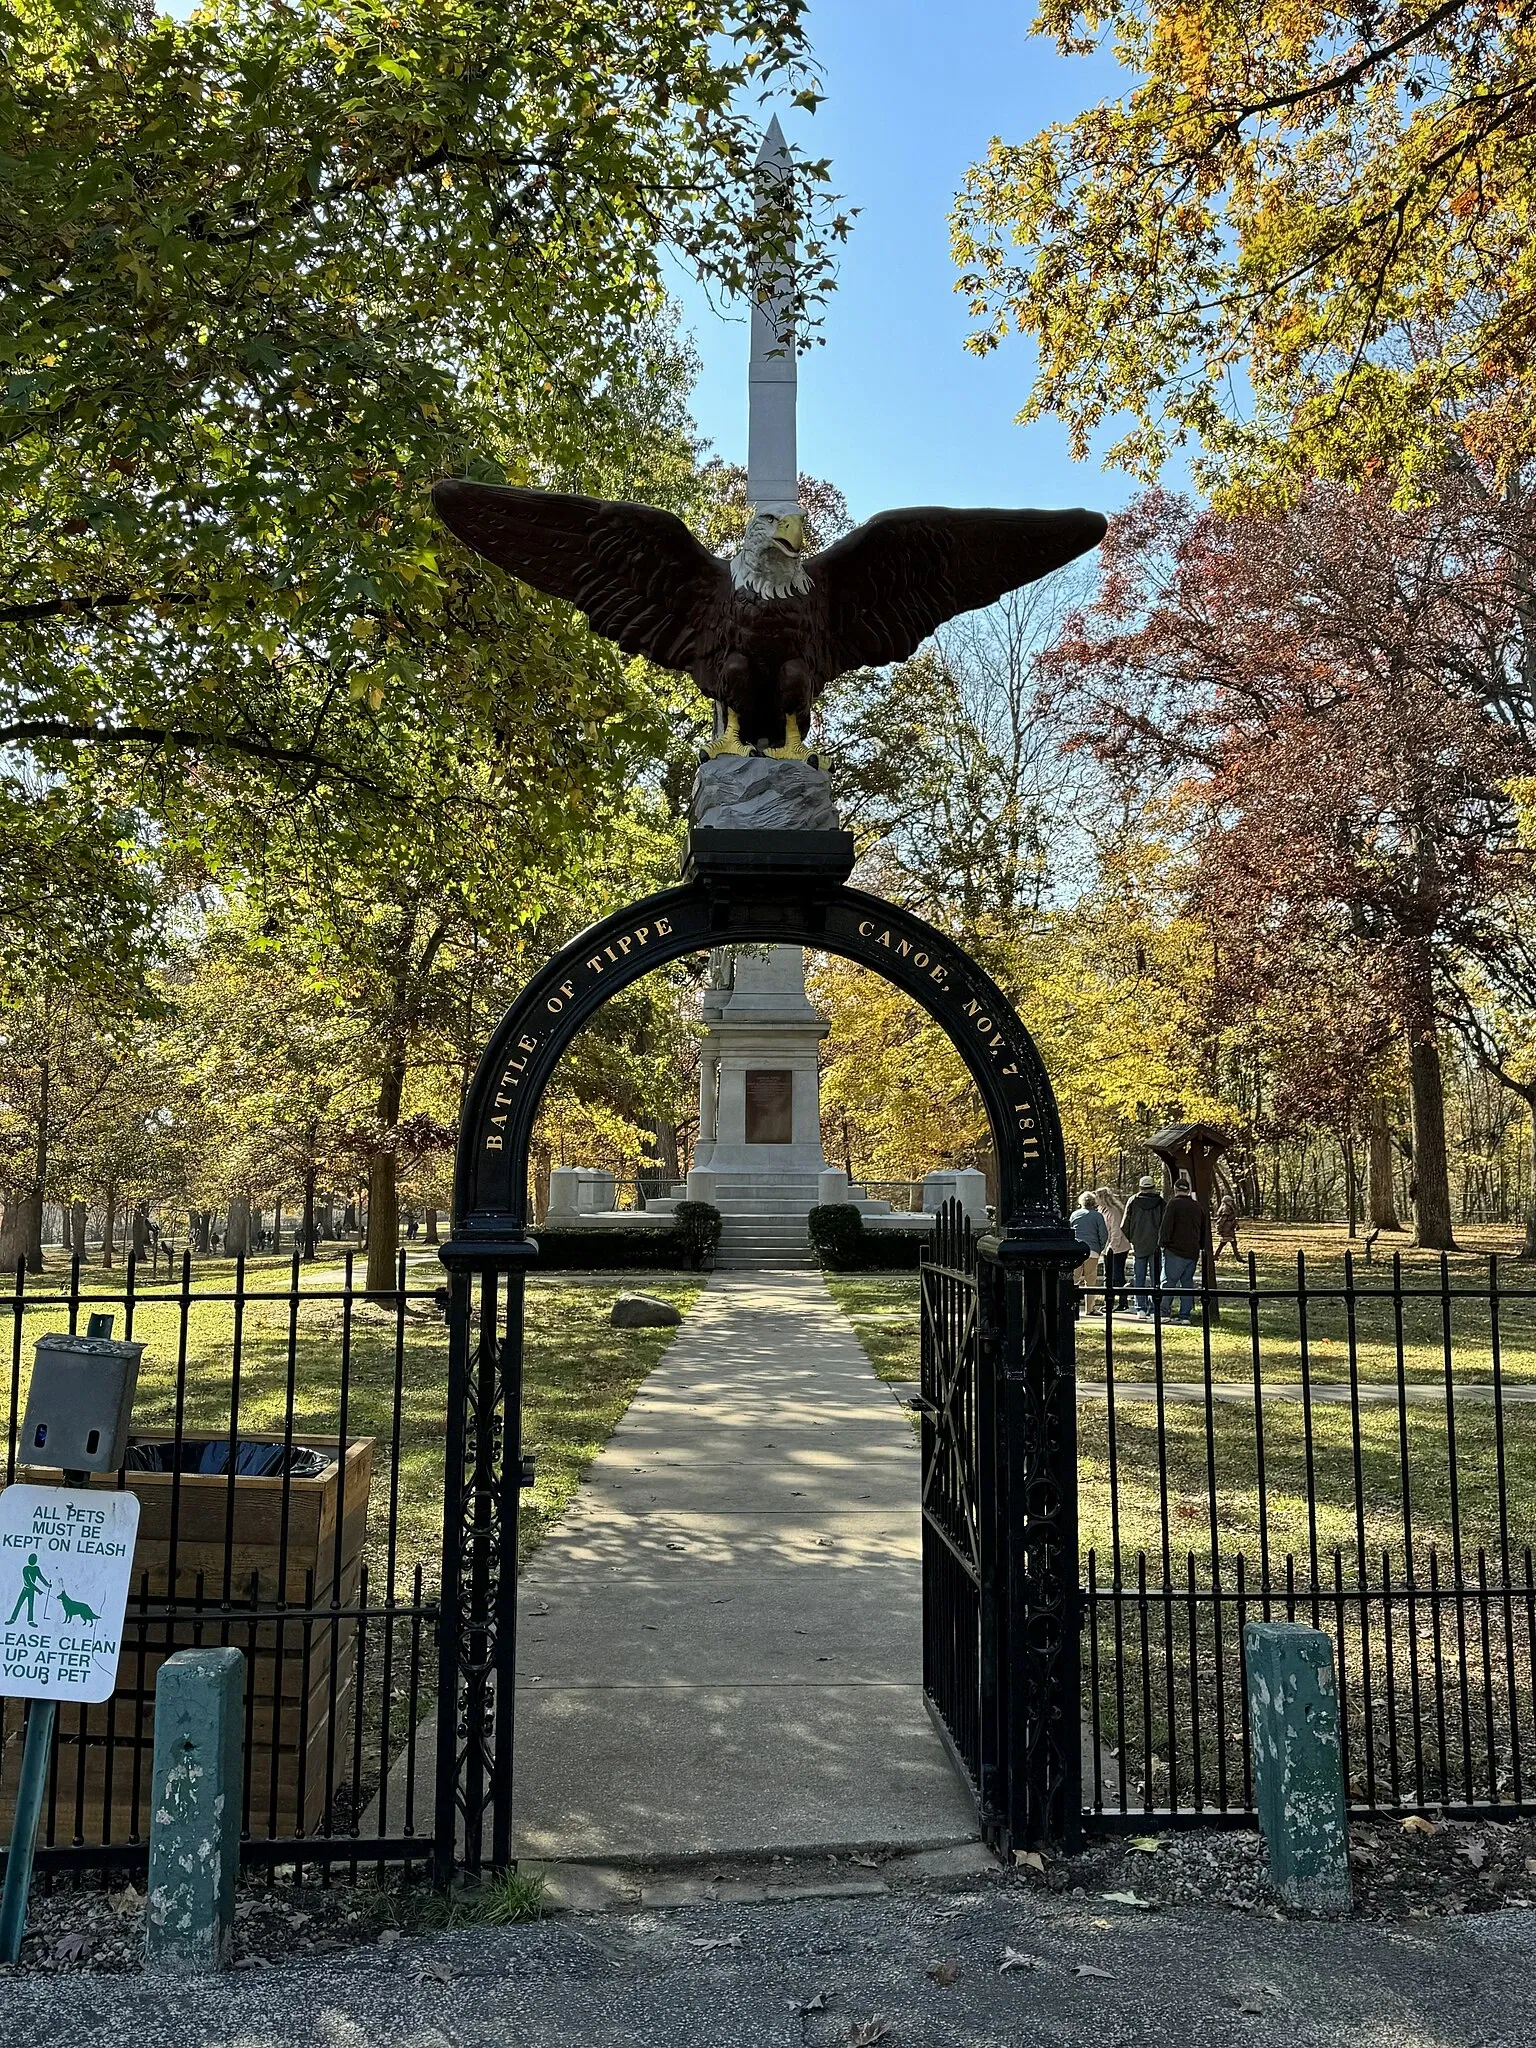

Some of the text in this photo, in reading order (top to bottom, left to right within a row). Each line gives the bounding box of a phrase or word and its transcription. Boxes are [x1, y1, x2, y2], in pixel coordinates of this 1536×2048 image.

[858, 920, 951, 991] CANOE,
[486, 916, 673, 1151] BATTLE OF TIPPE
[33, 1505, 105, 1524] ALL PETS
[32, 1520, 102, 1539] MUST BE
[2, 1534, 126, 1557] KEPT ON LEASH
[58, 1636, 116, 1655] CLEAN
[5, 1648, 91, 1667] UP AFTER
[2, 1663, 91, 1683] YOUR PET
